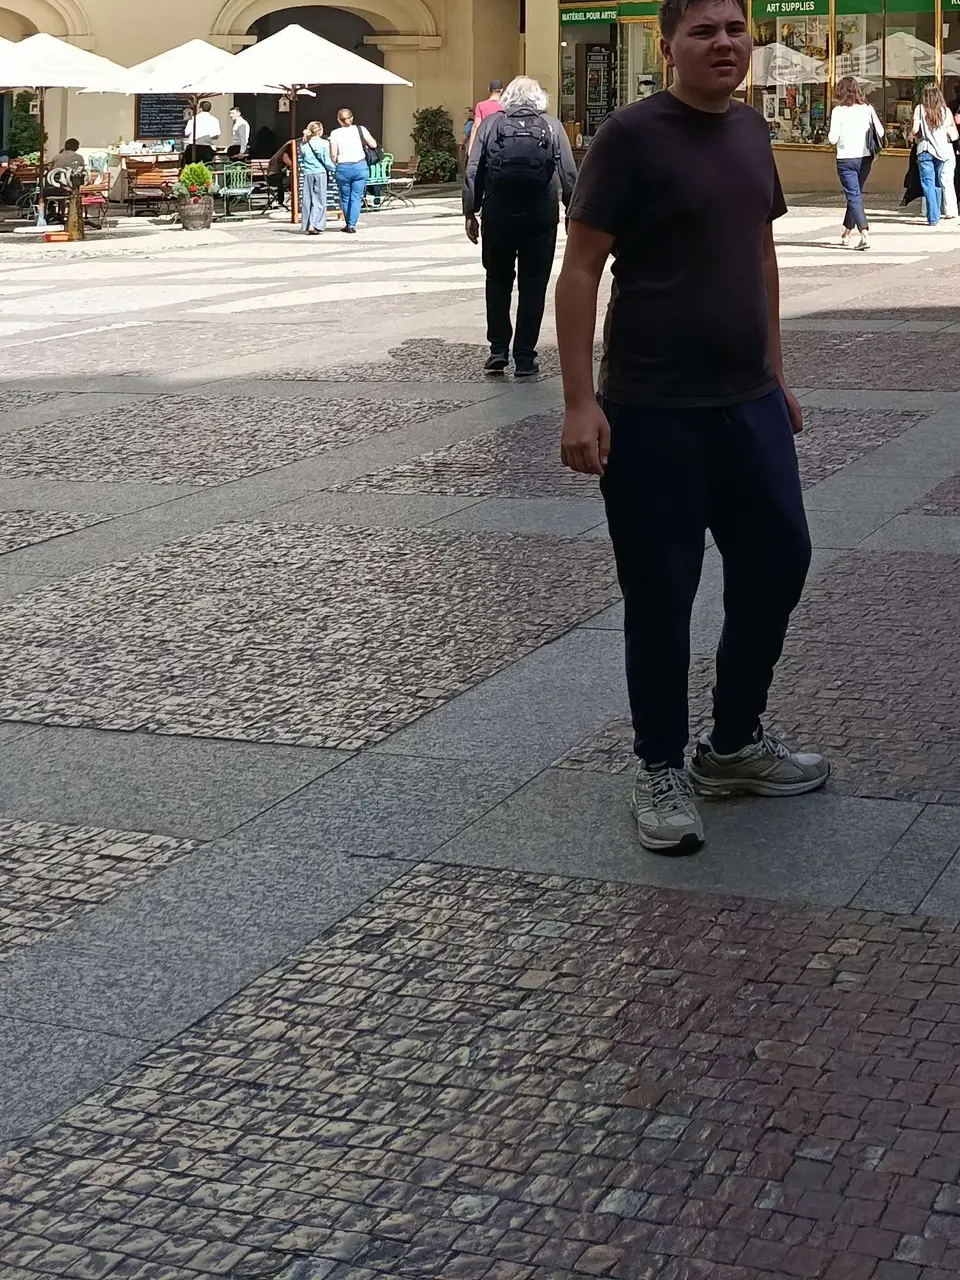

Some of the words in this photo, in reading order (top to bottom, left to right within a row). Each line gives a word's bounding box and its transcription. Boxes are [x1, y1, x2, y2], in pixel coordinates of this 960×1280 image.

[766, 2, 780, 13] ART
[781, 1, 815, 12] SUPPLIES
[562, 11, 585, 21] MATÉRIEL
[586, 11, 600, 20] POUR
